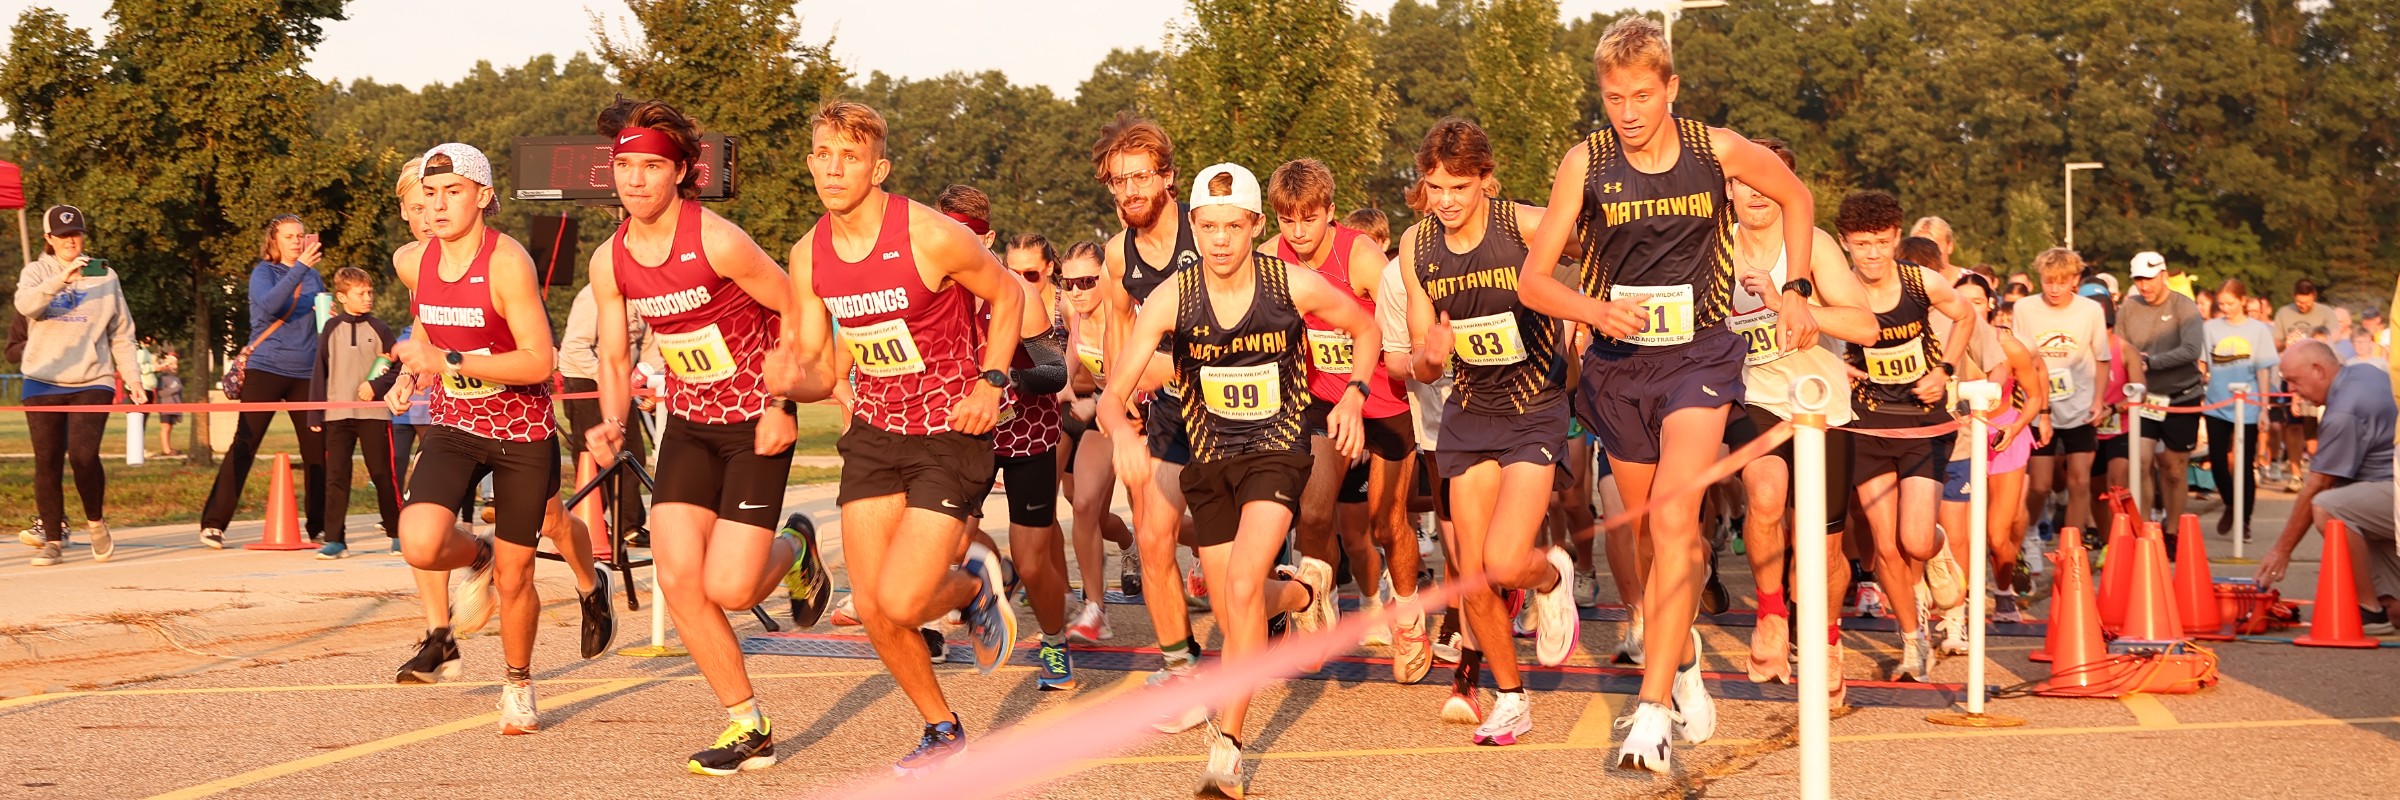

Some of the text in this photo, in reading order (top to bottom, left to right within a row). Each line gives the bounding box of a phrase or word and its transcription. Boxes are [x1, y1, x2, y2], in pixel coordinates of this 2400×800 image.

[1601, 191, 1713, 228] MATTAWAN
[680, 251, 697, 262] BOA
[882, 250, 900, 260] BOA
[1427, 266, 1518, 302] MATTAWAN
[1758, 312, 1778, 321] WILDCA
[1468, 332, 1504, 355] 83
[1641, 335, 1655, 343] AND
[677, 349, 712, 372] 10
[855, 339, 908, 366] 240
[1318, 343, 1354, 364] 313
[1876, 355, 1917, 376] 190
[1223, 384, 1259, 409] 99
